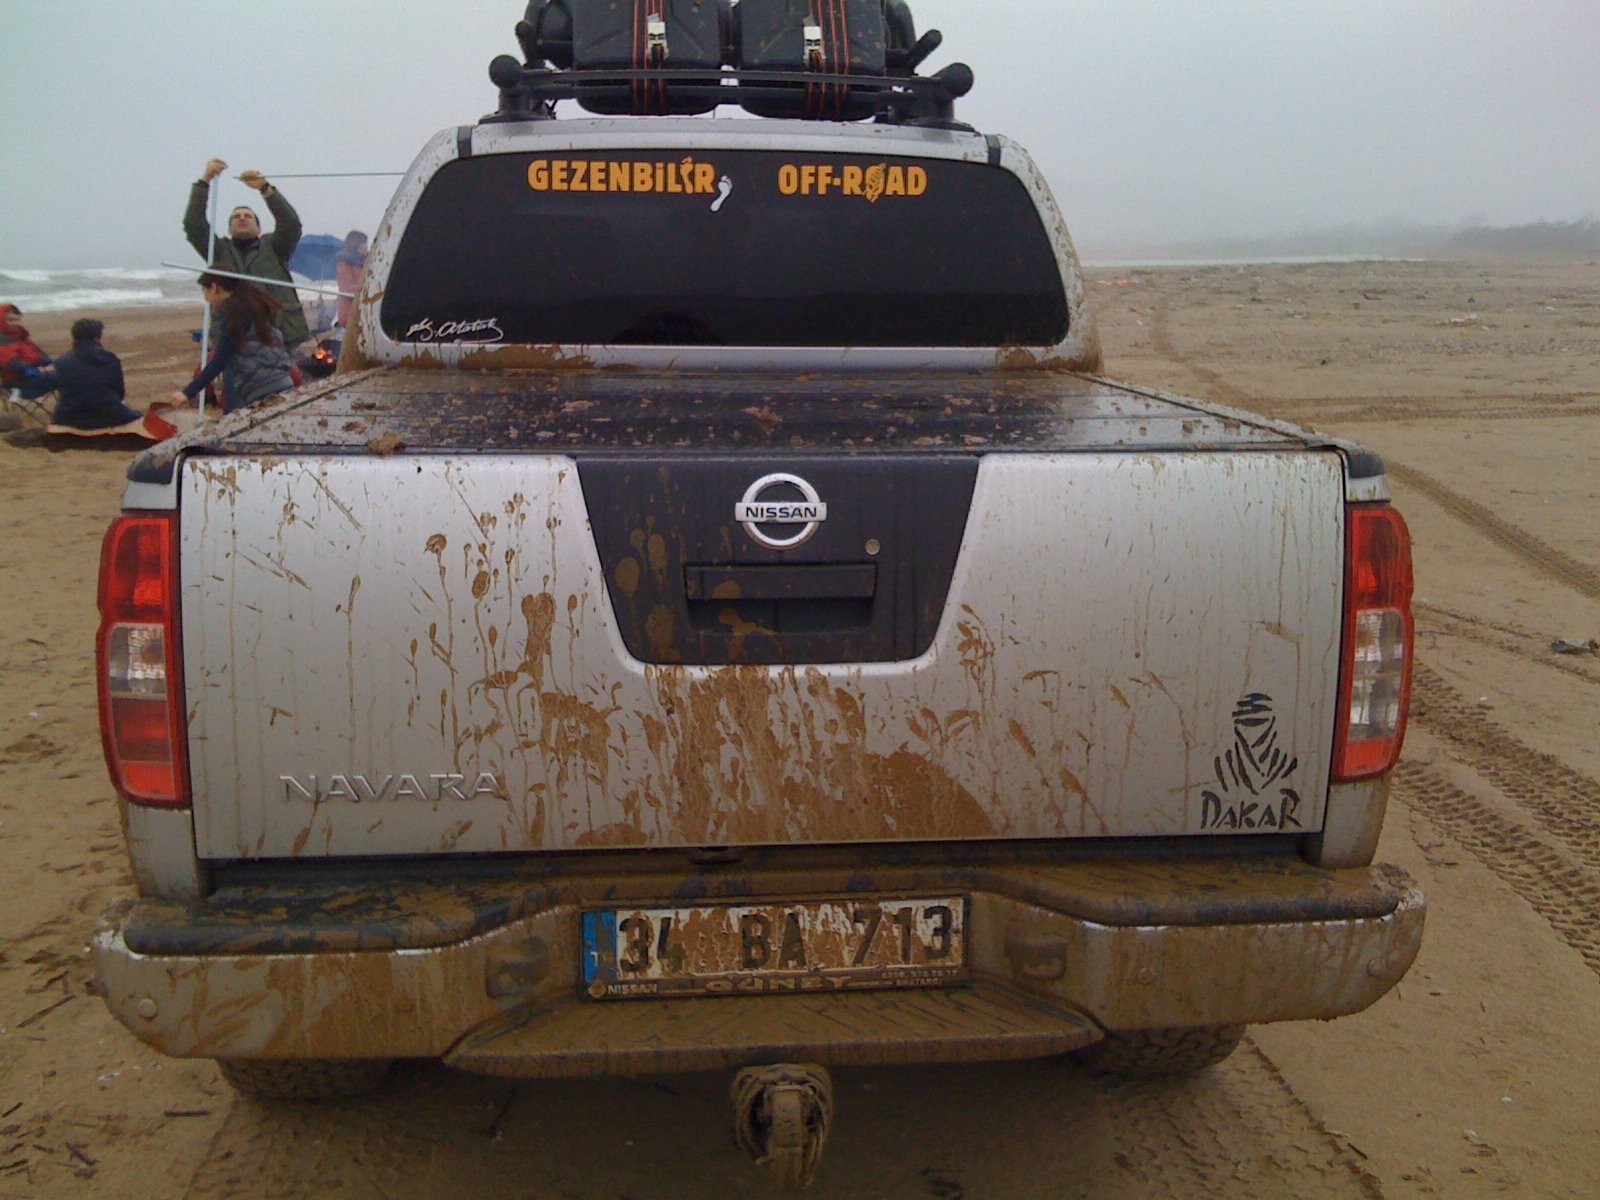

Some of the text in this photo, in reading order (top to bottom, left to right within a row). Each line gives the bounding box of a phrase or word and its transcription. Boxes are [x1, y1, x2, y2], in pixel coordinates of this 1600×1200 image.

[778, 163, 928, 203] OFF-ROAD
[745, 506, 817, 519] NISSAN
[279, 773, 501, 802] NAVARA
[1200, 788, 1303, 830] DAKAR
[741, 913, 807, 971] BA
[852, 904, 952, 967] 713
[607, 983, 658, 996] NISSAN
